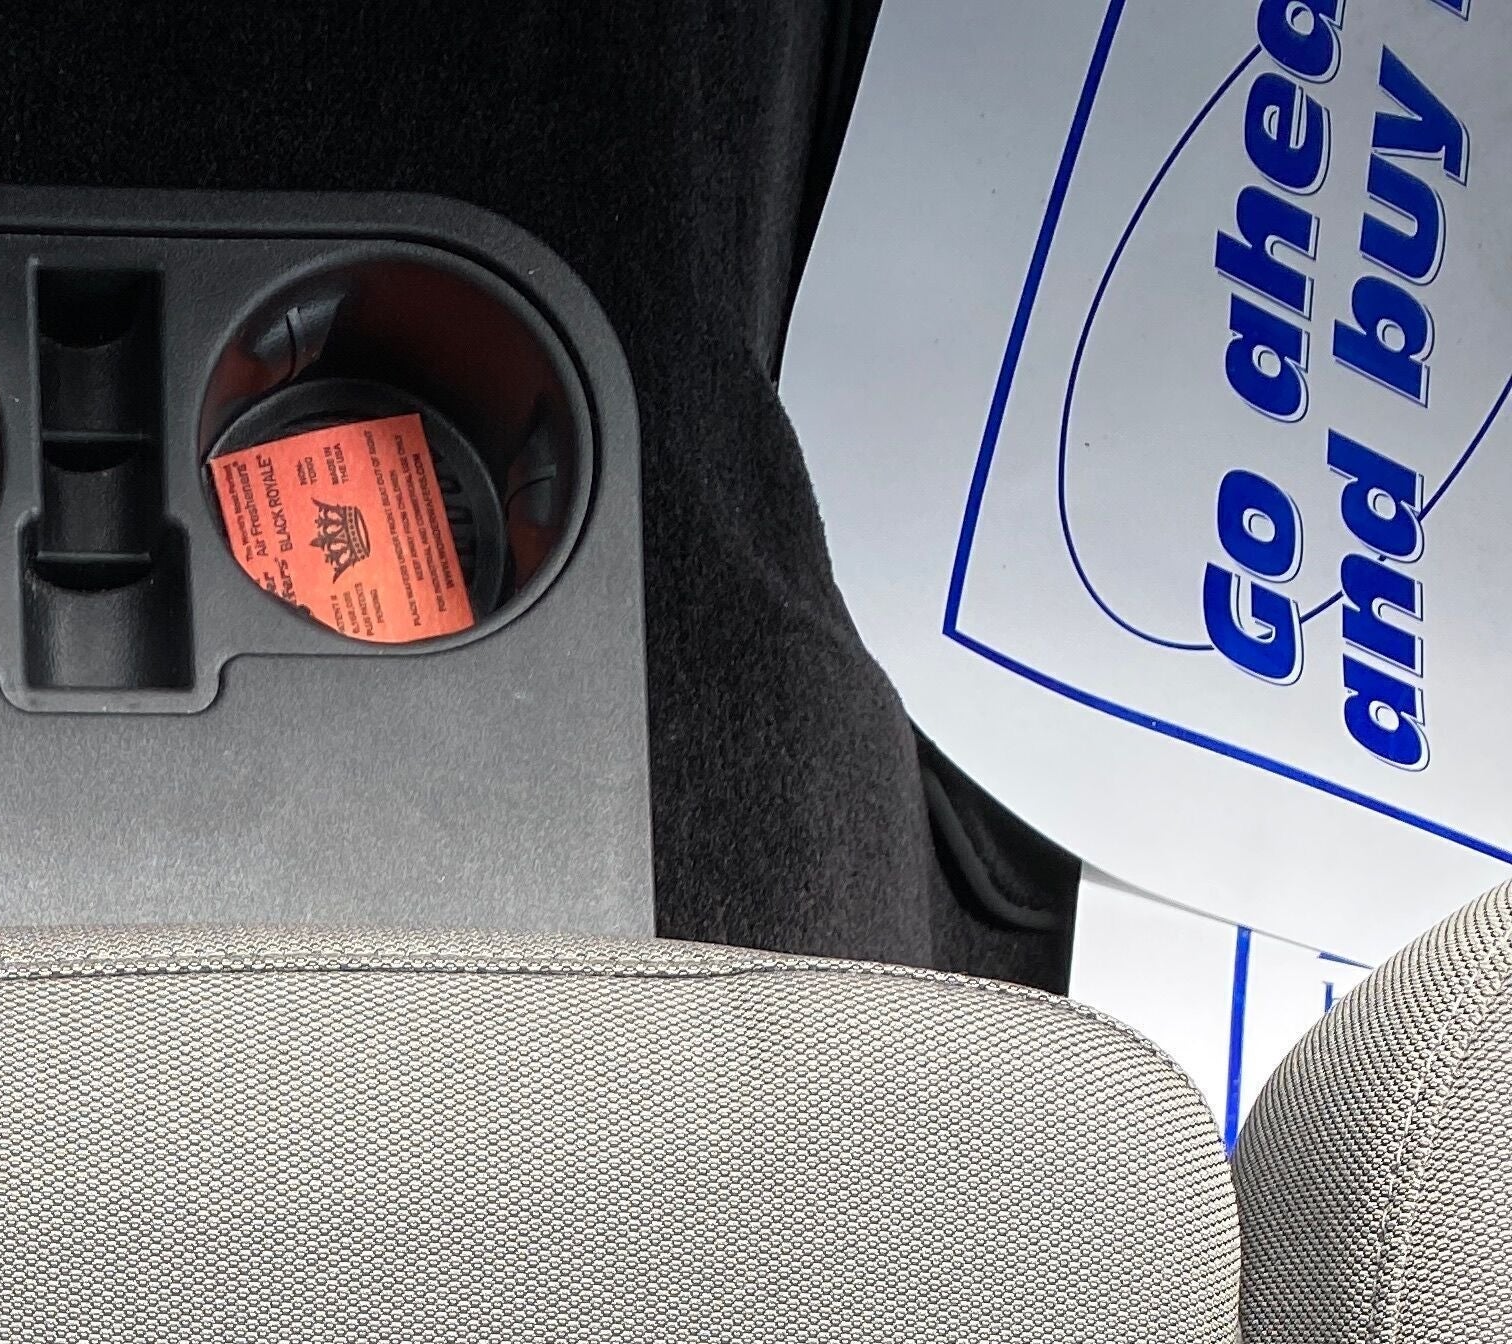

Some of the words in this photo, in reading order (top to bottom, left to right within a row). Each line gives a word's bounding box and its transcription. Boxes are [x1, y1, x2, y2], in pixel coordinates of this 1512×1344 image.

[1332, 45, 1470, 408] buy
[323, 446, 331, 457] IN
[333, 442, 344, 463] USA
[363, 430, 376, 454] SIGHT
[326, 458, 338, 485] MADE
[338, 464, 348, 483] THE
[370, 456, 380, 467] OF
[373, 468, 384, 485] OUT
[389, 468, 405, 509] CHILDREN
[271, 508, 293, 552] BLACK
[384, 508, 396, 535] FRONT
[400, 511, 409, 533] FROM
[254, 538, 268, 556] Air
[407, 536, 417, 557] AWAY
[418, 527, 428, 544] AND
[391, 535, 405, 563] UNDER
[399, 564, 413, 599] WAFERS
[412, 559, 423, 580] KEEP
[1203, 470, 1303, 686] Go
[354, 582, 367, 615] PATENTS
[369, 588, 383, 623] PENDING
[436, 595, 445, 611] FOR
[1327, 429, 1430, 771] and
[331, 603, 345, 633] ATENT
[408, 600, 421, 626] PLACE
[362, 616, 374, 636] PLUS
